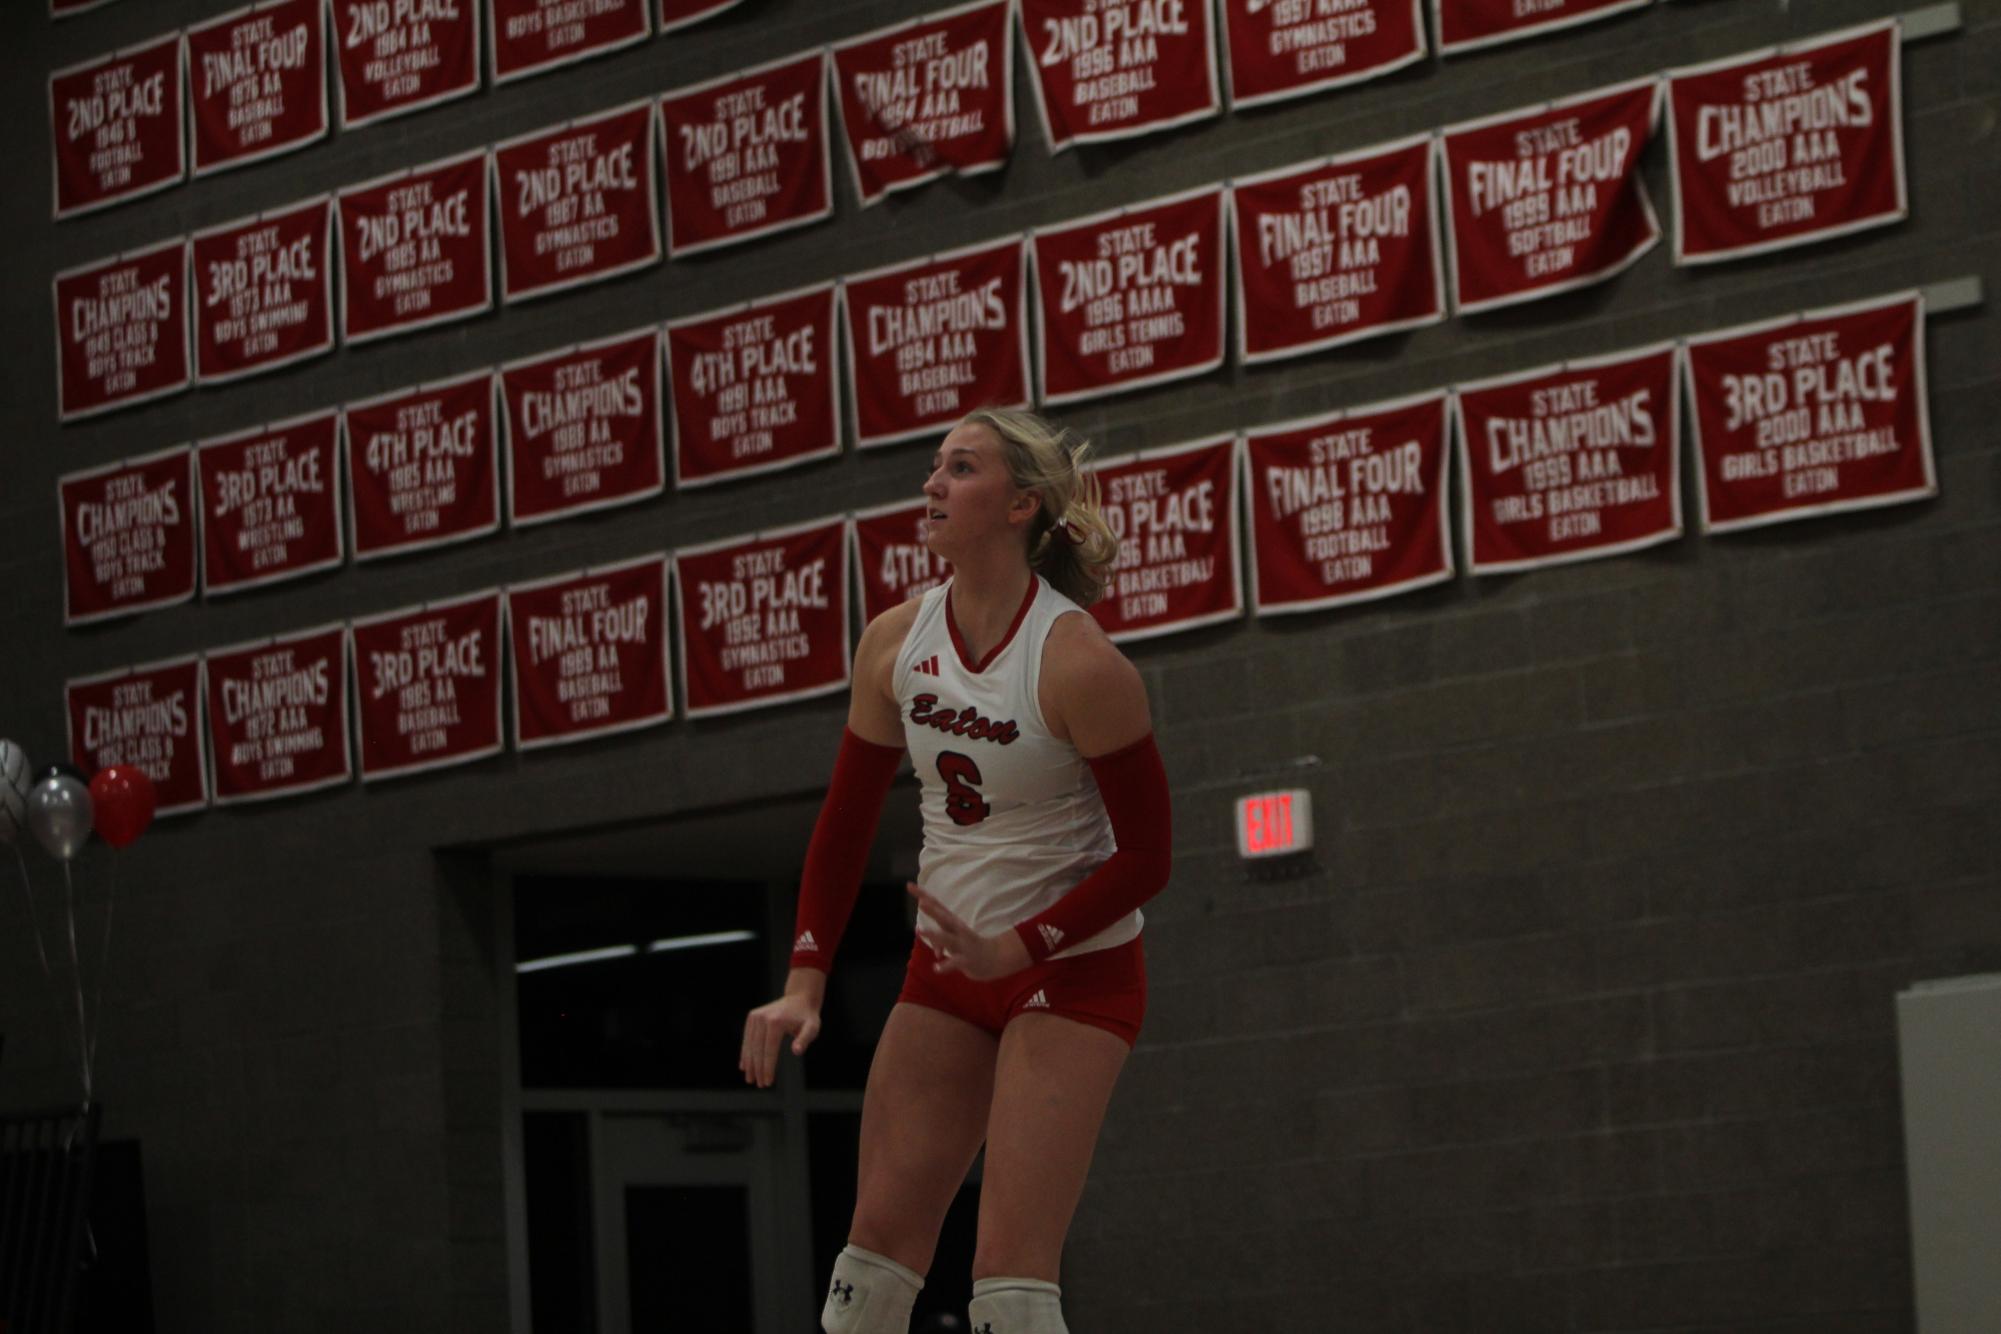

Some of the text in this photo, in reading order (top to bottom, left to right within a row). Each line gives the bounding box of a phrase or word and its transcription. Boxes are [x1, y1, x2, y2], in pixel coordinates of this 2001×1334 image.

[346, 3, 393, 48] 2ND
[548, 21, 584, 48] EATON
[1041, 10, 1104, 66] 2ND
[203, 24, 307, 97] FINAL FOUR
[893, 31, 948, 67] STATE
[925, 39, 989, 91] FOUR
[1298, 43, 1345, 72] EATON
[383, 74, 420, 98] EATON
[1744, 62, 1812, 100] STATE
[68, 72, 163, 139] 2ND PLACE
[715, 86, 764, 120] STATE
[1089, 96, 1137, 124] EATON
[1697, 68, 1871, 160] CHAMPIONS
[680, 93, 807, 170] 2ND PLACE
[1515, 118, 1581, 156] STATE
[547, 134, 596, 169] STATE
[516, 142, 636, 216] 2ND PLACE
[1301, 174, 1362, 211] STATE
[1468, 156, 1551, 212] FINAL
[386, 182, 431, 215] STATE
[727, 199, 765, 227] EATON
[1759, 196, 1813, 227] EATON
[357, 190, 469, 261] 2ND PLACE
[1098, 223, 1154, 258] STATE
[1258, 185, 1409, 264] FINAL FOUR
[207, 234, 315, 305] 3RD PLACE
[557, 243, 593, 270] EATON
[1060, 233, 1201, 312] 2ND PLACE
[1526, 244, 1573, 276] EATON
[395, 288, 430, 314] EATON
[905, 270, 960, 305] STATE
[72, 274, 170, 341] CHAMPIONS
[868, 277, 1005, 355] CHAMPIONS
[1313, 298, 1358, 328] EATON
[723, 316, 773, 348] STATE
[691, 325, 815, 394] 4TH PLACE
[1109, 345, 1153, 372] EATON
[1768, 332, 1837, 370] STATE
[554, 359, 601, 390] STATE
[1723, 344, 1895, 429] 3RD PLACE
[397, 400, 441, 432] STATE
[522, 367, 642, 437] CHAMPIONS
[916, 388, 959, 415] EATON
[1532, 380, 1597, 416] STATE
[367, 411, 476, 471] 4TH PLACE
[733, 430, 772, 457] EATON
[1310, 428, 1371, 462] STATE
[1487, 389, 1653, 472] CHAMPIONS
[215, 447, 322, 516] 3RD PLACE
[564, 470, 599, 495] EATON
[1108, 470, 1169, 502] STATE
[1266, 441, 1422, 519] FINAL FOUR
[1784, 467, 1838, 497] EATON
[77, 480, 179, 545] CHAMPIONS
[1130, 480, 1214, 537] PLACE
[1549, 511, 1600, 540] EATON
[733, 548, 783, 581] STATE
[880, 545, 930, 591] 4TH
[1323, 555, 1371, 583] EATON
[562, 584, 608, 616] STATE
[699, 559, 826, 628] 3RD PLACE
[1121, 593, 1168, 620] EATON
[401, 619, 445, 651] STATE
[529, 596, 647, 662] FINAL FOUR
[371, 630, 484, 698] 3RD PLACE
[744, 663, 784, 688] EATON
[222, 658, 328, 723] CHAMPIONS
[571, 695, 609, 720] EATON
[84, 691, 186, 749] CHAMPIONS
[910, 693, 1019, 745] Eaton
[411, 728, 447, 752] EATON
[935, 750, 991, 826] 6
[1245, 793, 1294, 853] EXIT
